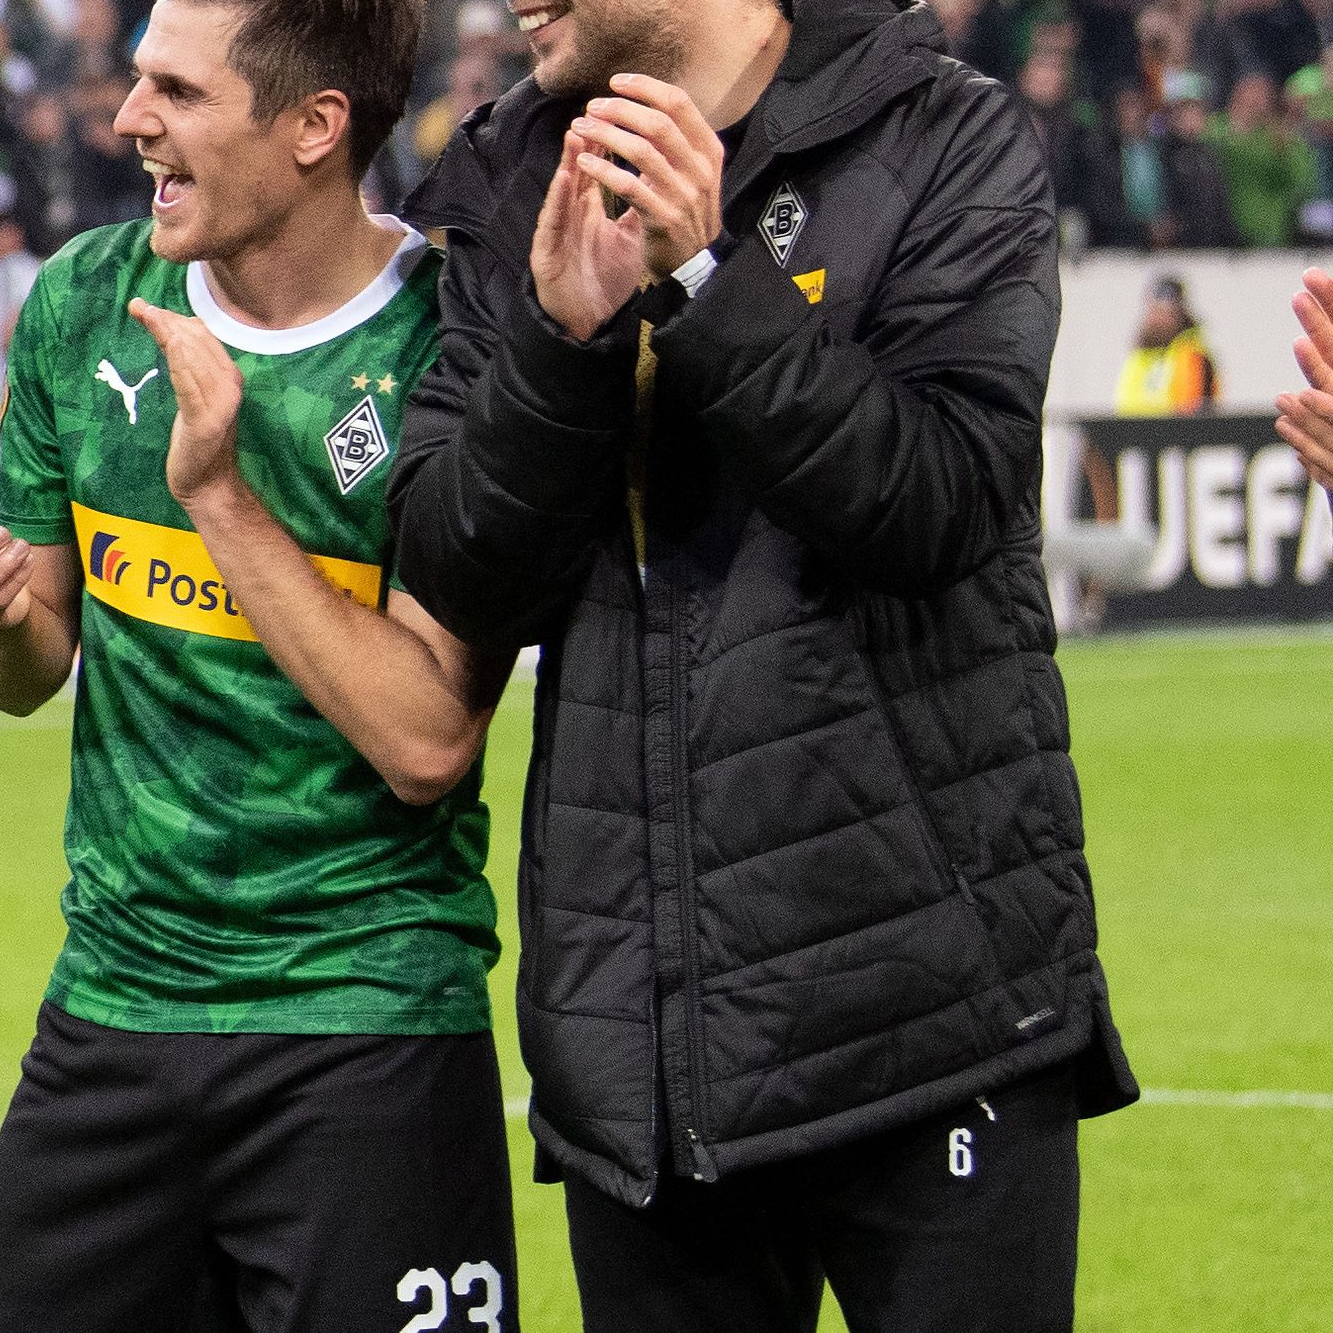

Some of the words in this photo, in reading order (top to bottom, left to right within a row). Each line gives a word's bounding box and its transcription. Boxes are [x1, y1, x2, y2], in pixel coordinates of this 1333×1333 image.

[146, 558, 242, 617] Post
[947, 1127, 973, 1178] 6
[396, 1260, 503, 1333] 23
